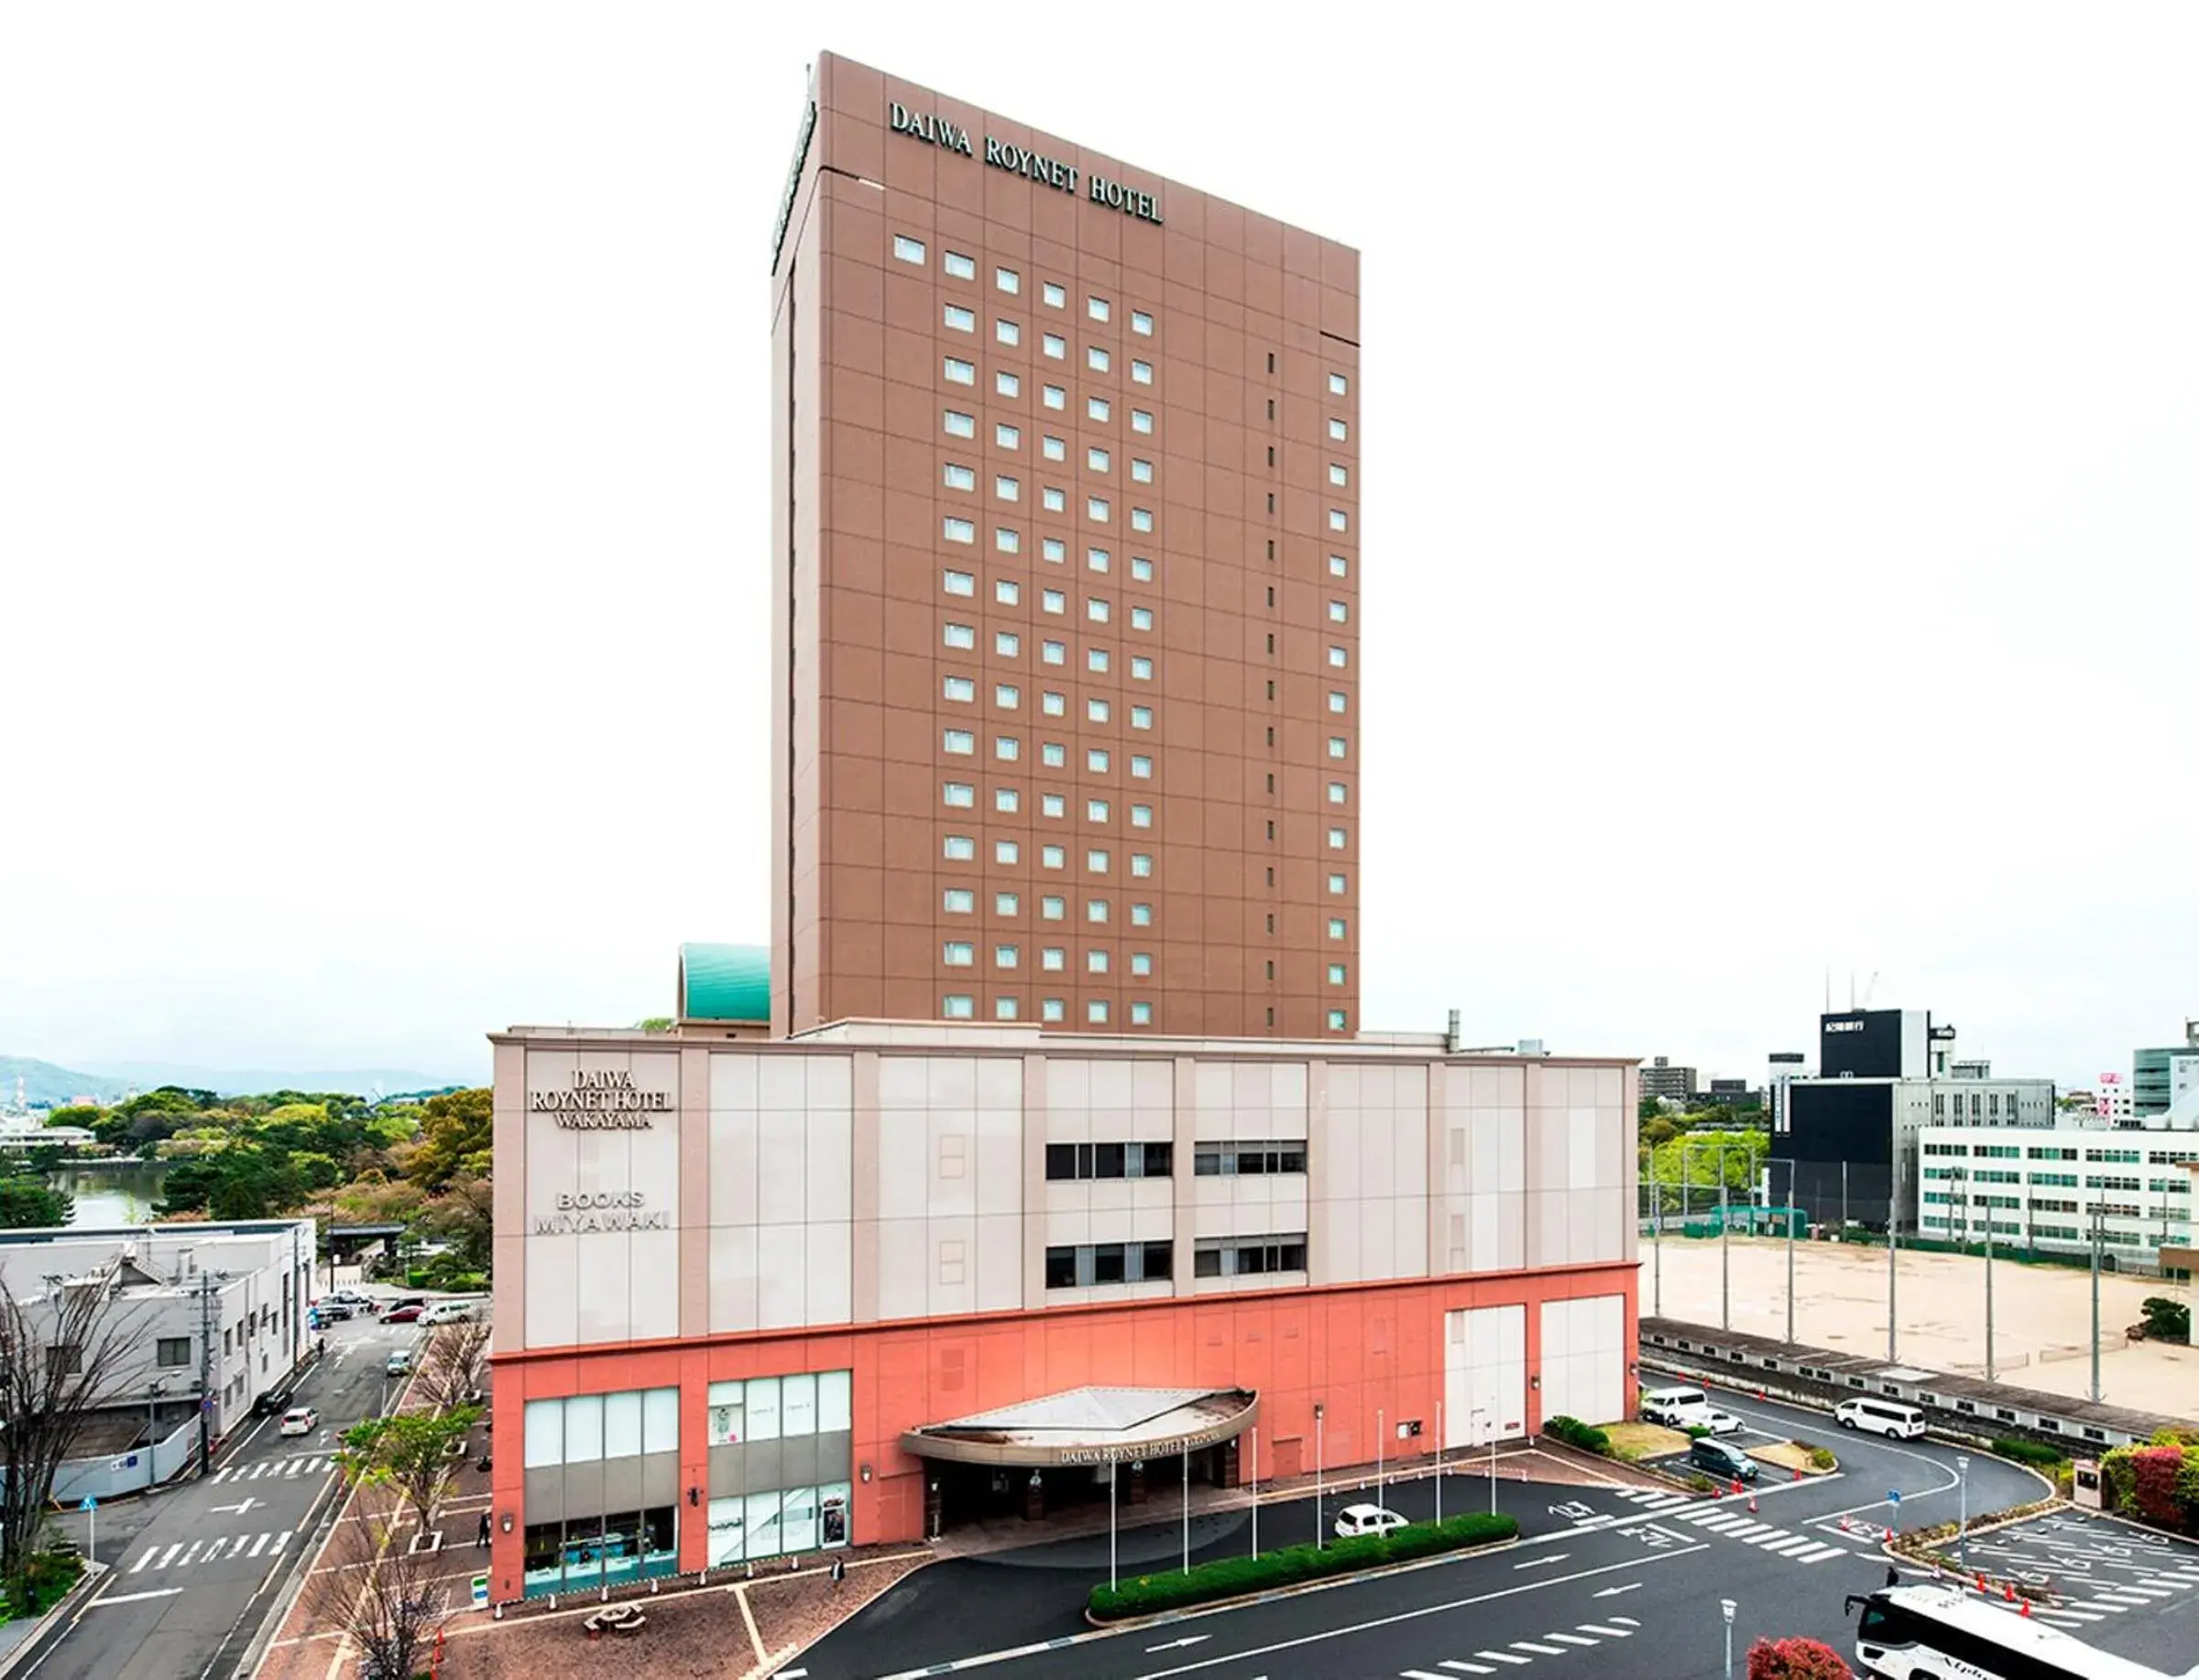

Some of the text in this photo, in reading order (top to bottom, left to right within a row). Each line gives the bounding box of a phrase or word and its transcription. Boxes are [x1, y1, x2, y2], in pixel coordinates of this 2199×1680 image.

[891, 103, 1164, 224] DAIWA ROYNET HOTEL
[572, 1069, 637, 1091] DAIWA
[531, 1091, 673, 1111] ROYNET HOTEL
[554, 1112, 653, 1129] WAKAYAMA
[556, 1191, 645, 1210] BOOKS
[536, 1210, 672, 1235] MIYAWAKI
[1061, 1448, 1100, 1464] DAIWA
[1149, 1438, 1183, 1456] HOTEL
